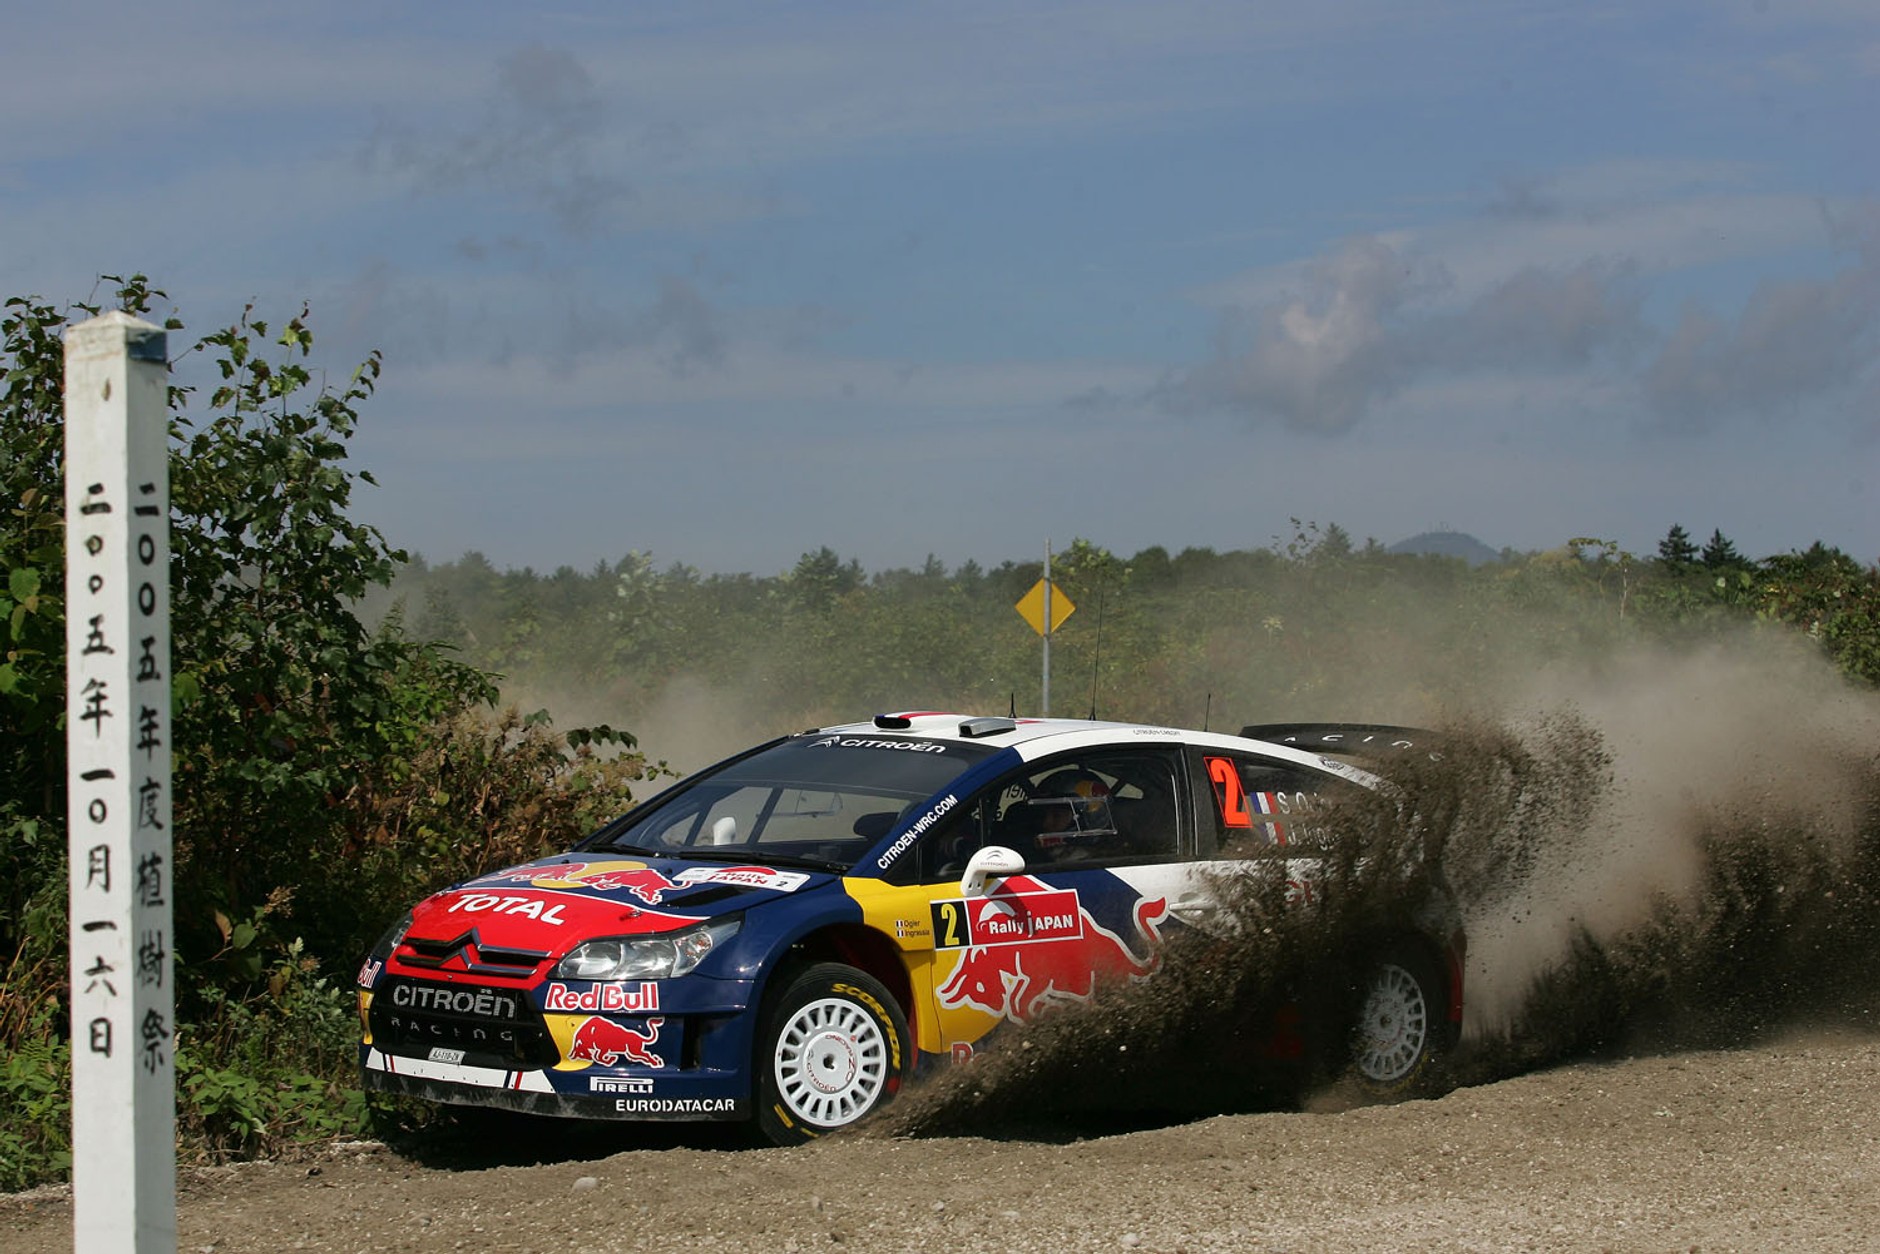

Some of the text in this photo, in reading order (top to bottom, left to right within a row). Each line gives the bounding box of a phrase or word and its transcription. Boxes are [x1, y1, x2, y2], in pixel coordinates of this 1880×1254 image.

[1210, 759, 1251, 825] 2
[877, 794, 958, 870] CITROEN-WRC.COM
[448, 893, 566, 925] TOTAL
[904, 920, 920, 928] Ogier
[941, 903, 960, 946] 2
[989, 920, 1024, 934] Rally
[545, 982, 659, 1010] Red Bull
[590, 1076, 654, 1093] PIRELLI
[616, 1099, 735, 1112] EURODATACAR
